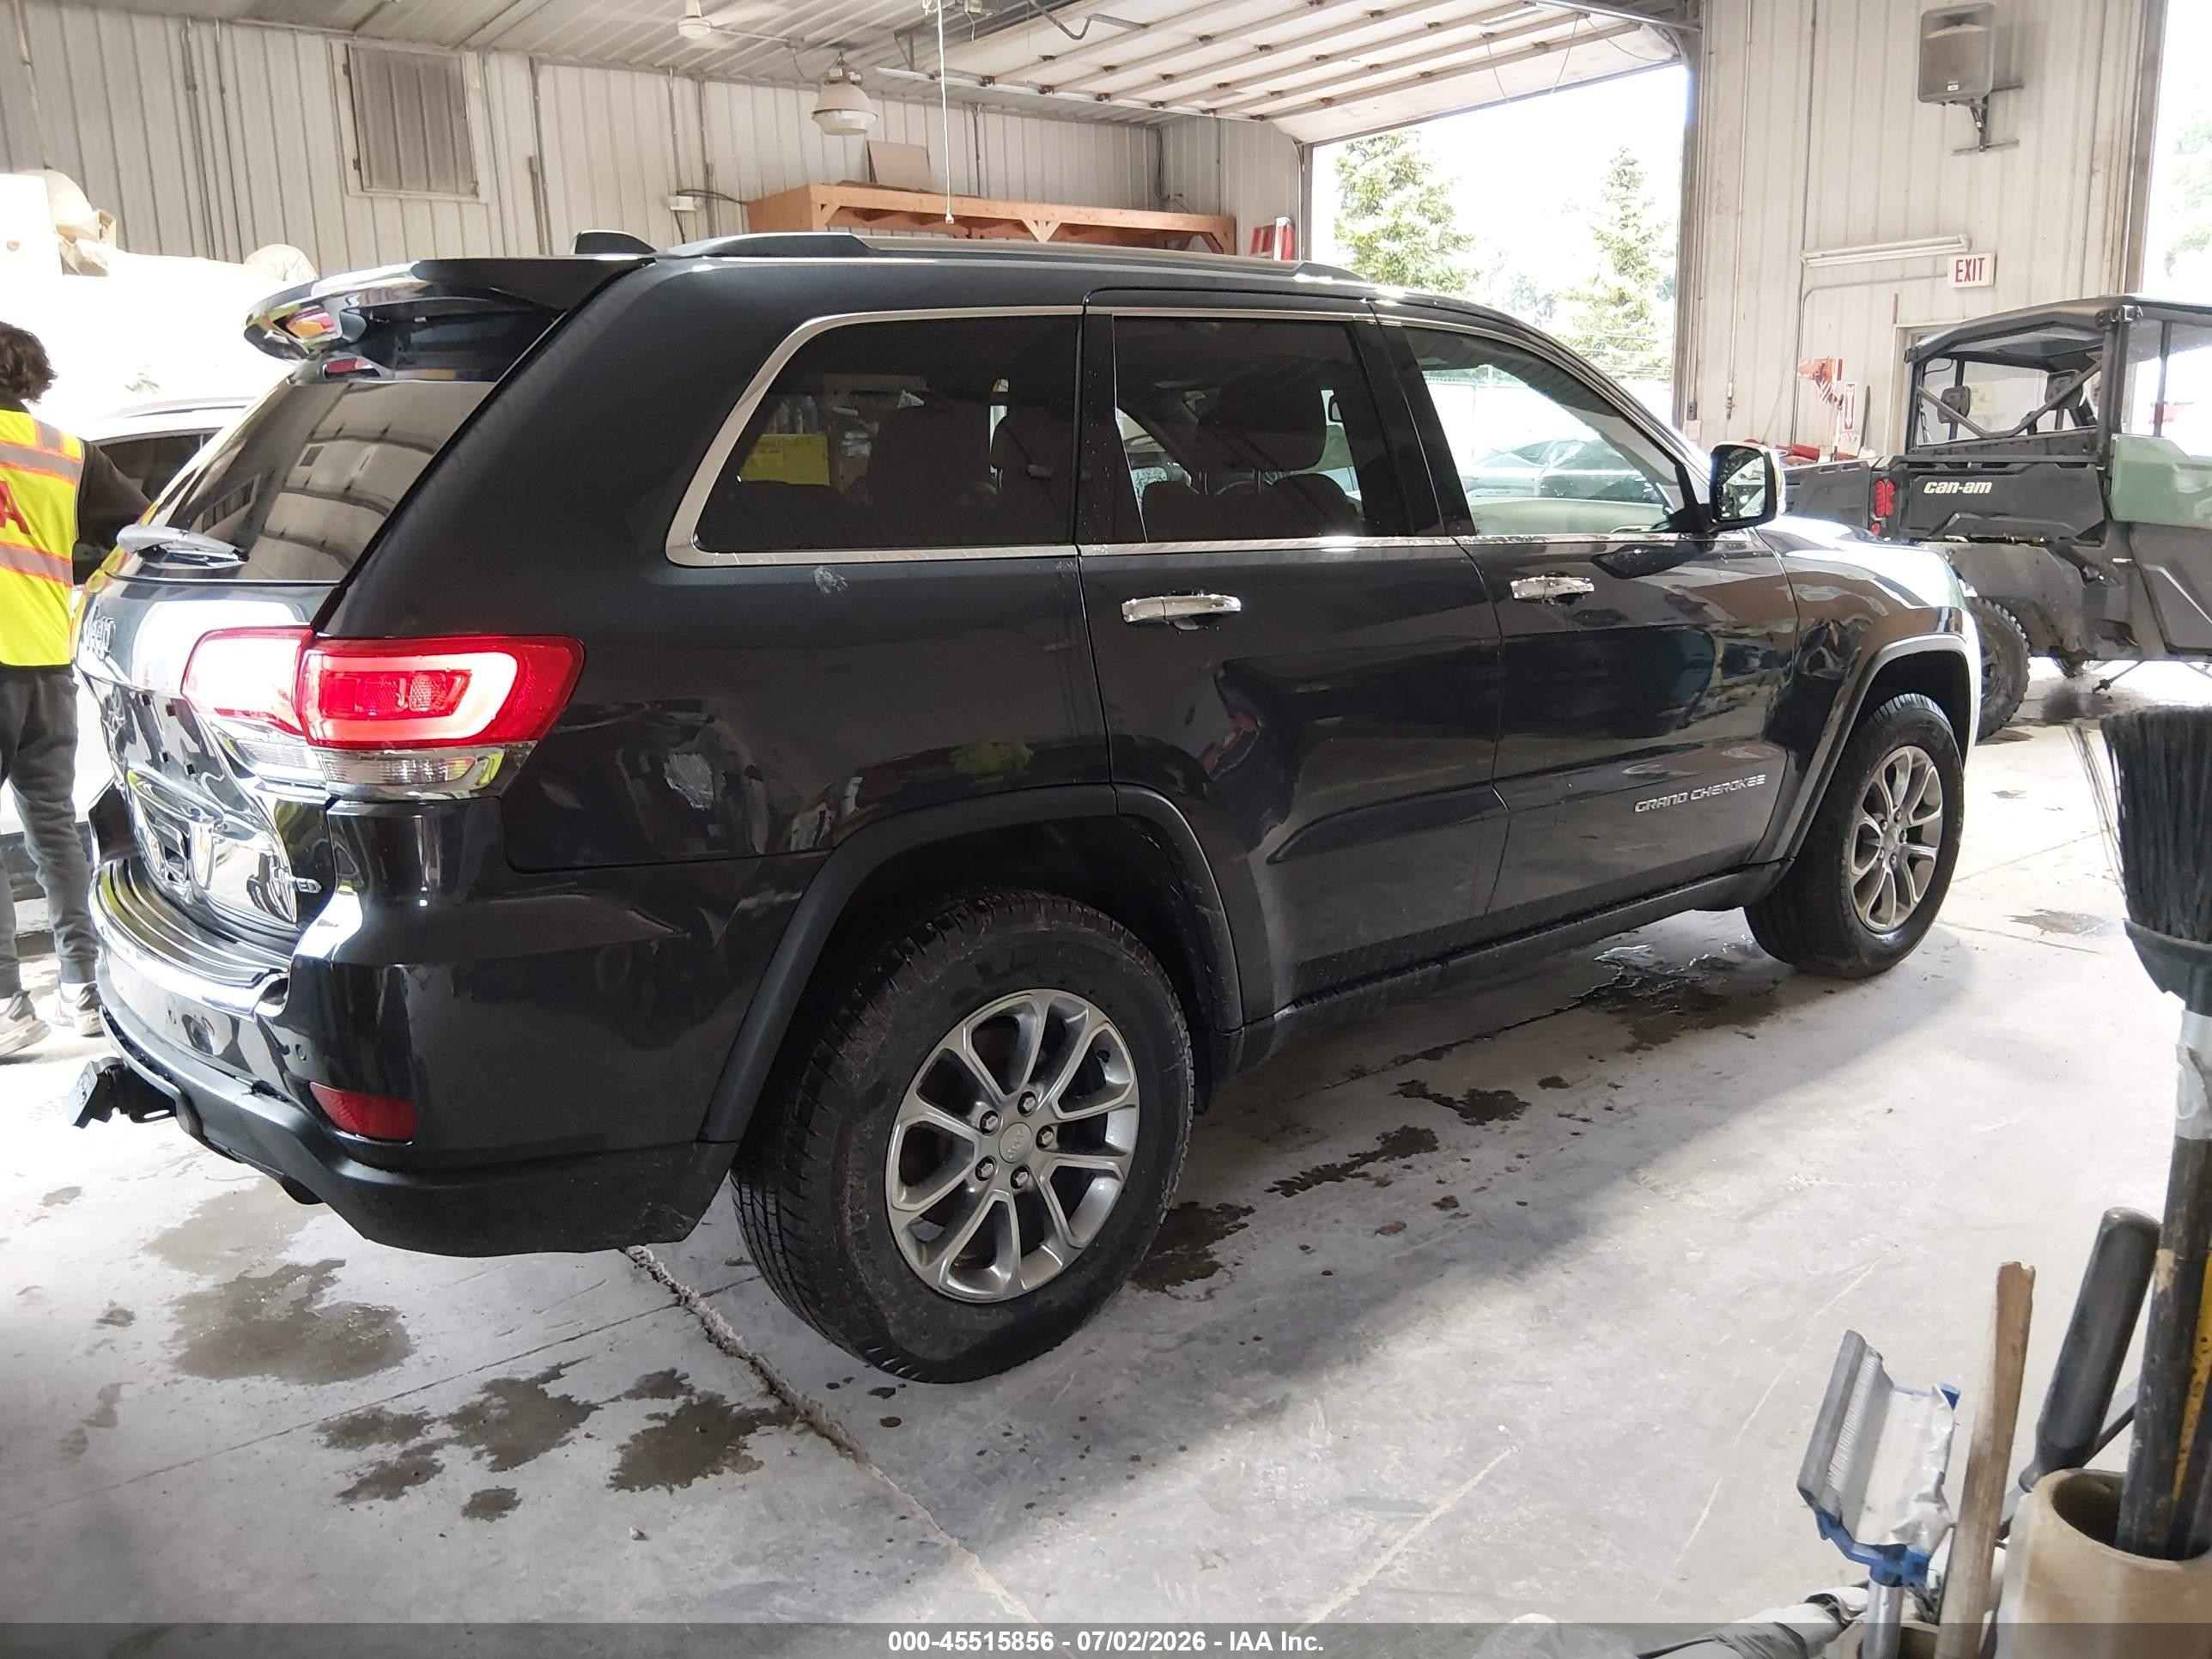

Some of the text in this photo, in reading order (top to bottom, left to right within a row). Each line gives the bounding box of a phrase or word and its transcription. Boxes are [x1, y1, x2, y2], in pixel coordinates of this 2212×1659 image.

[1955, 257, 1985, 283] EXIT
[1923, 482, 1993, 495] can-am
[1634, 774, 1766, 813] GRAND CHEROKEE
